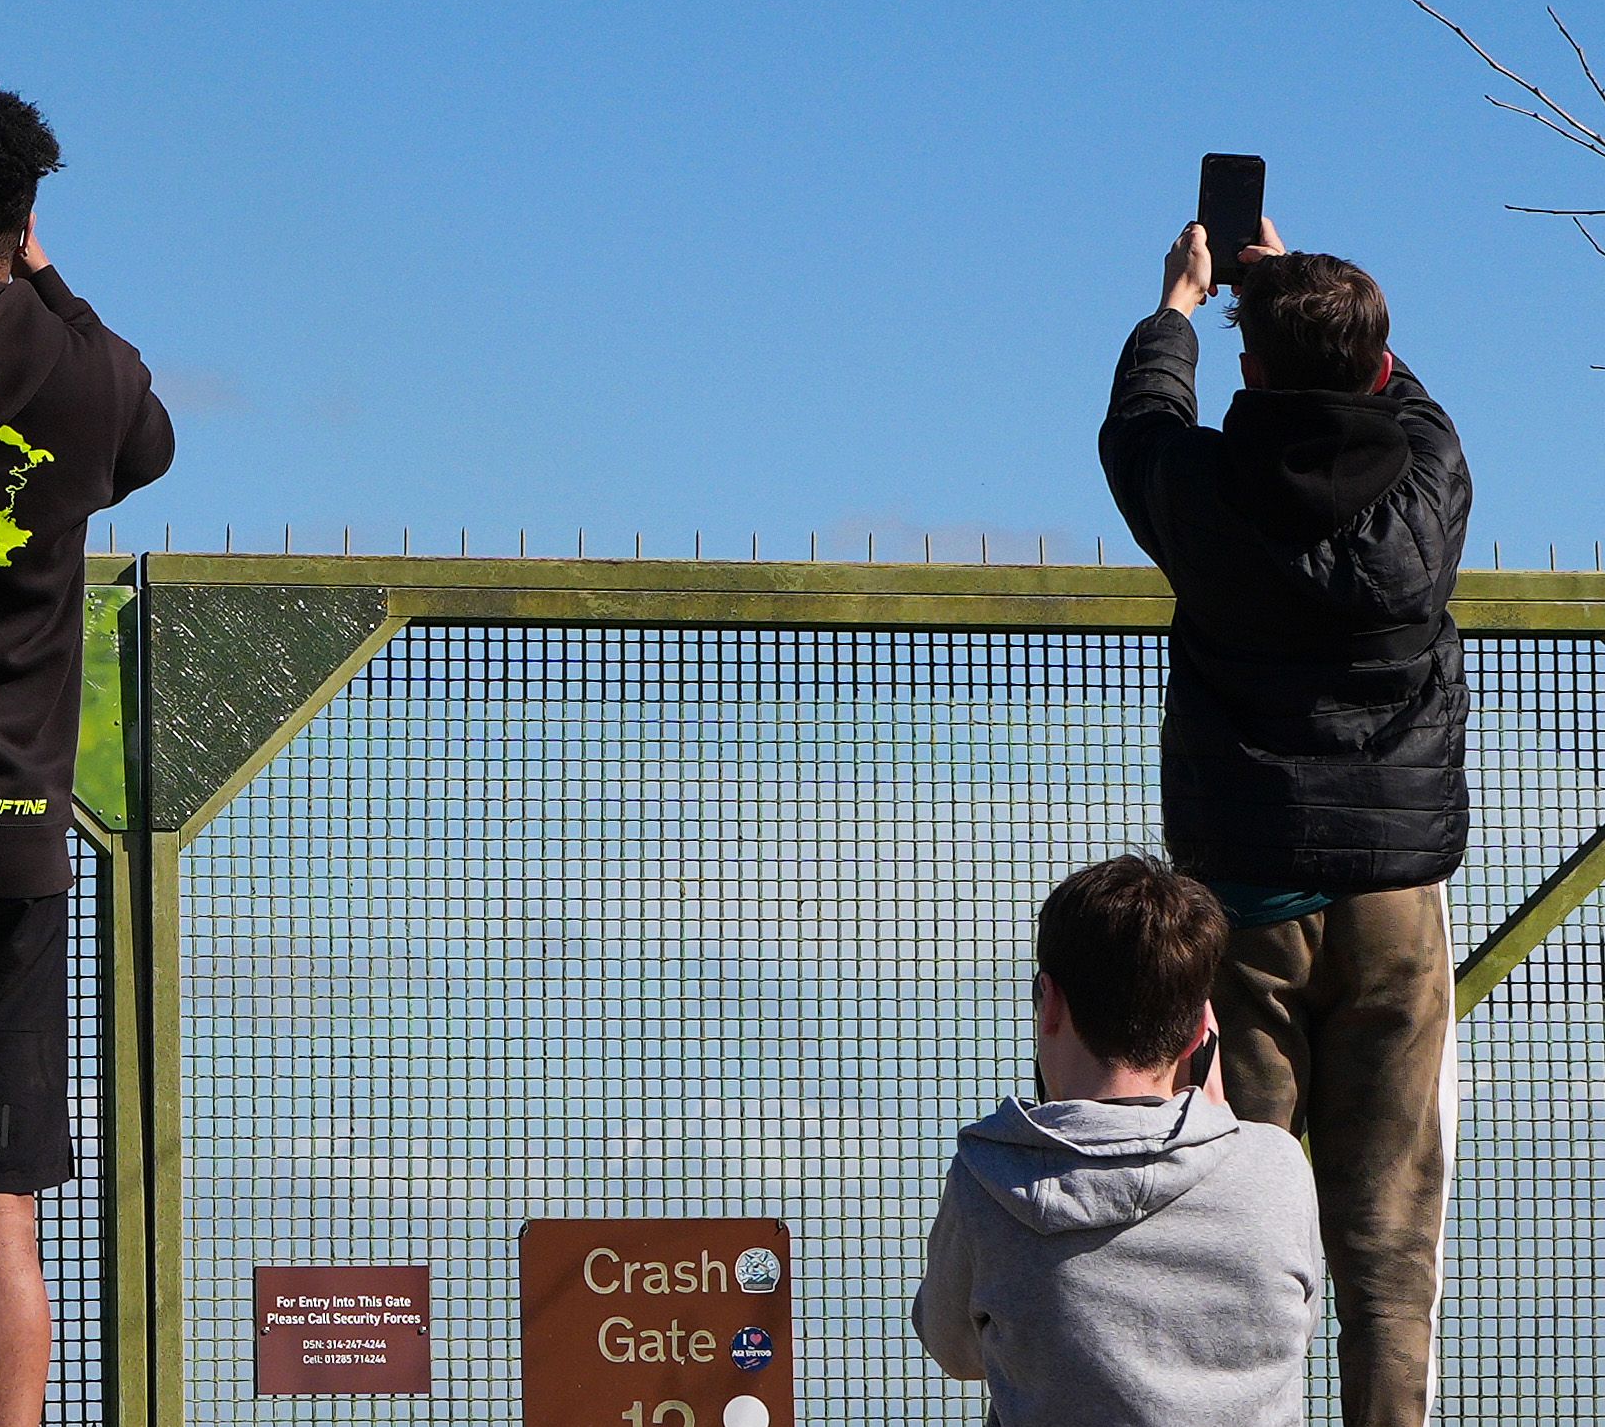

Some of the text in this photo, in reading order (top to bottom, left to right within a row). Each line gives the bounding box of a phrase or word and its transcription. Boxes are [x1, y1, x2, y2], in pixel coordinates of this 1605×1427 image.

[584, 1247, 728, 1294] Crash
[277, 1296, 411, 1310] For Entry Into This Gate
[267, 1313, 421, 1326] Please Call Security Forces
[303, 1340, 324, 1349] DSN:
[598, 1317, 717, 1362] Gate
